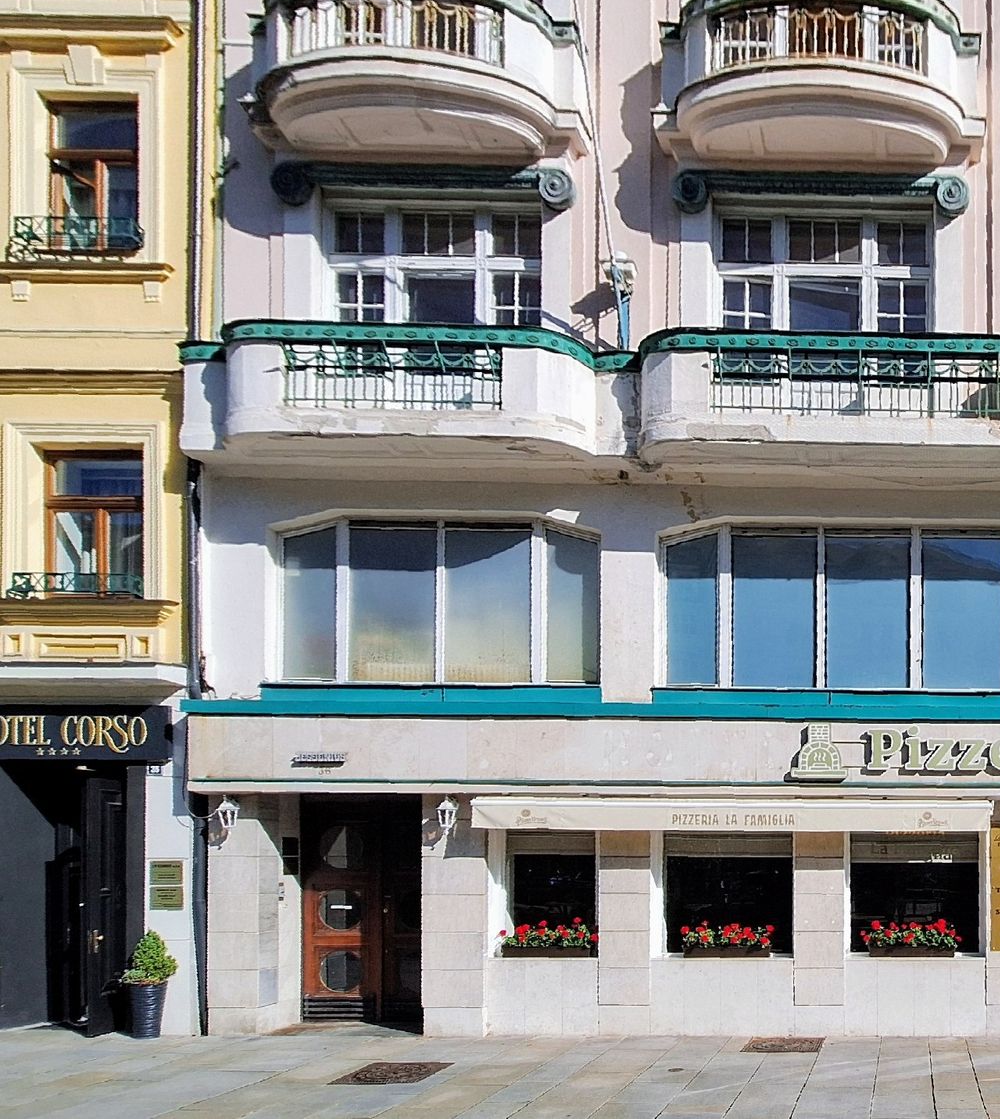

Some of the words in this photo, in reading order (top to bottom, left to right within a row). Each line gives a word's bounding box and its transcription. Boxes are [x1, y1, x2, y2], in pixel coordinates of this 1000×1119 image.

[60, 714, 148, 753] CORSO
[671, 813, 719, 826] PIZZERIA
[725, 813, 738, 825] LA
[744, 814, 795, 826] FAMIGLIA
